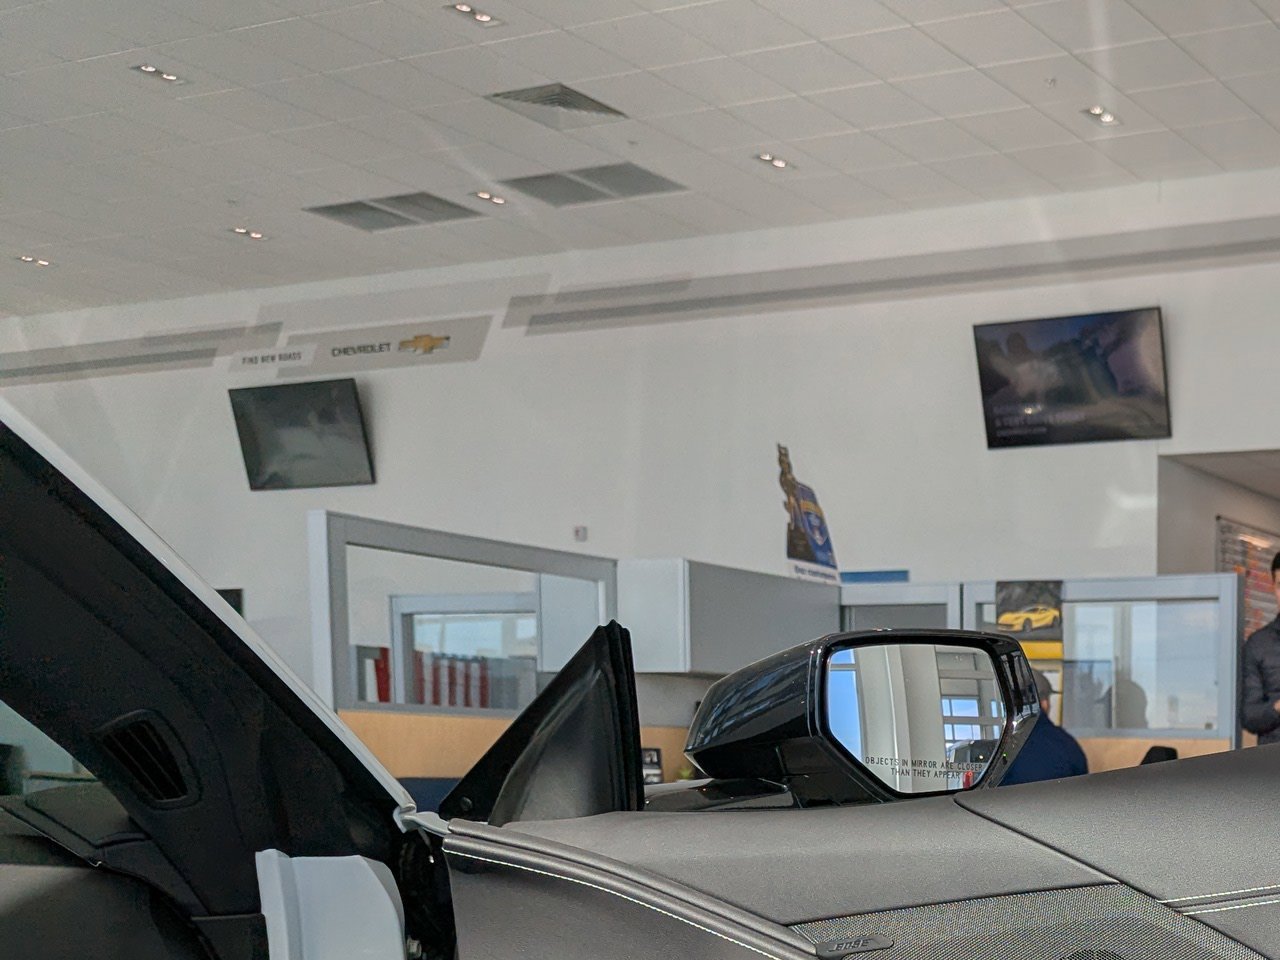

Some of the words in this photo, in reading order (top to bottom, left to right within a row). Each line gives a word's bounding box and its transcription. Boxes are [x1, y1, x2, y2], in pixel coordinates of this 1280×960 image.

[331, 343, 391, 357] CHEVROLET
[261, 354, 276, 363] NEW
[278, 352, 302, 361] ROADS
[865, 756, 899, 767] OBJECTS
[901, 759, 909, 767] IN
[911, 759, 937, 769] MIRROR
[940, 761, 954, 770] ARE
[957, 762, 983, 771] CLOSER
[891, 767, 911, 777] THAN
[913, 768, 930, 778] THEY
[933, 770, 960, 779] APPEAR
